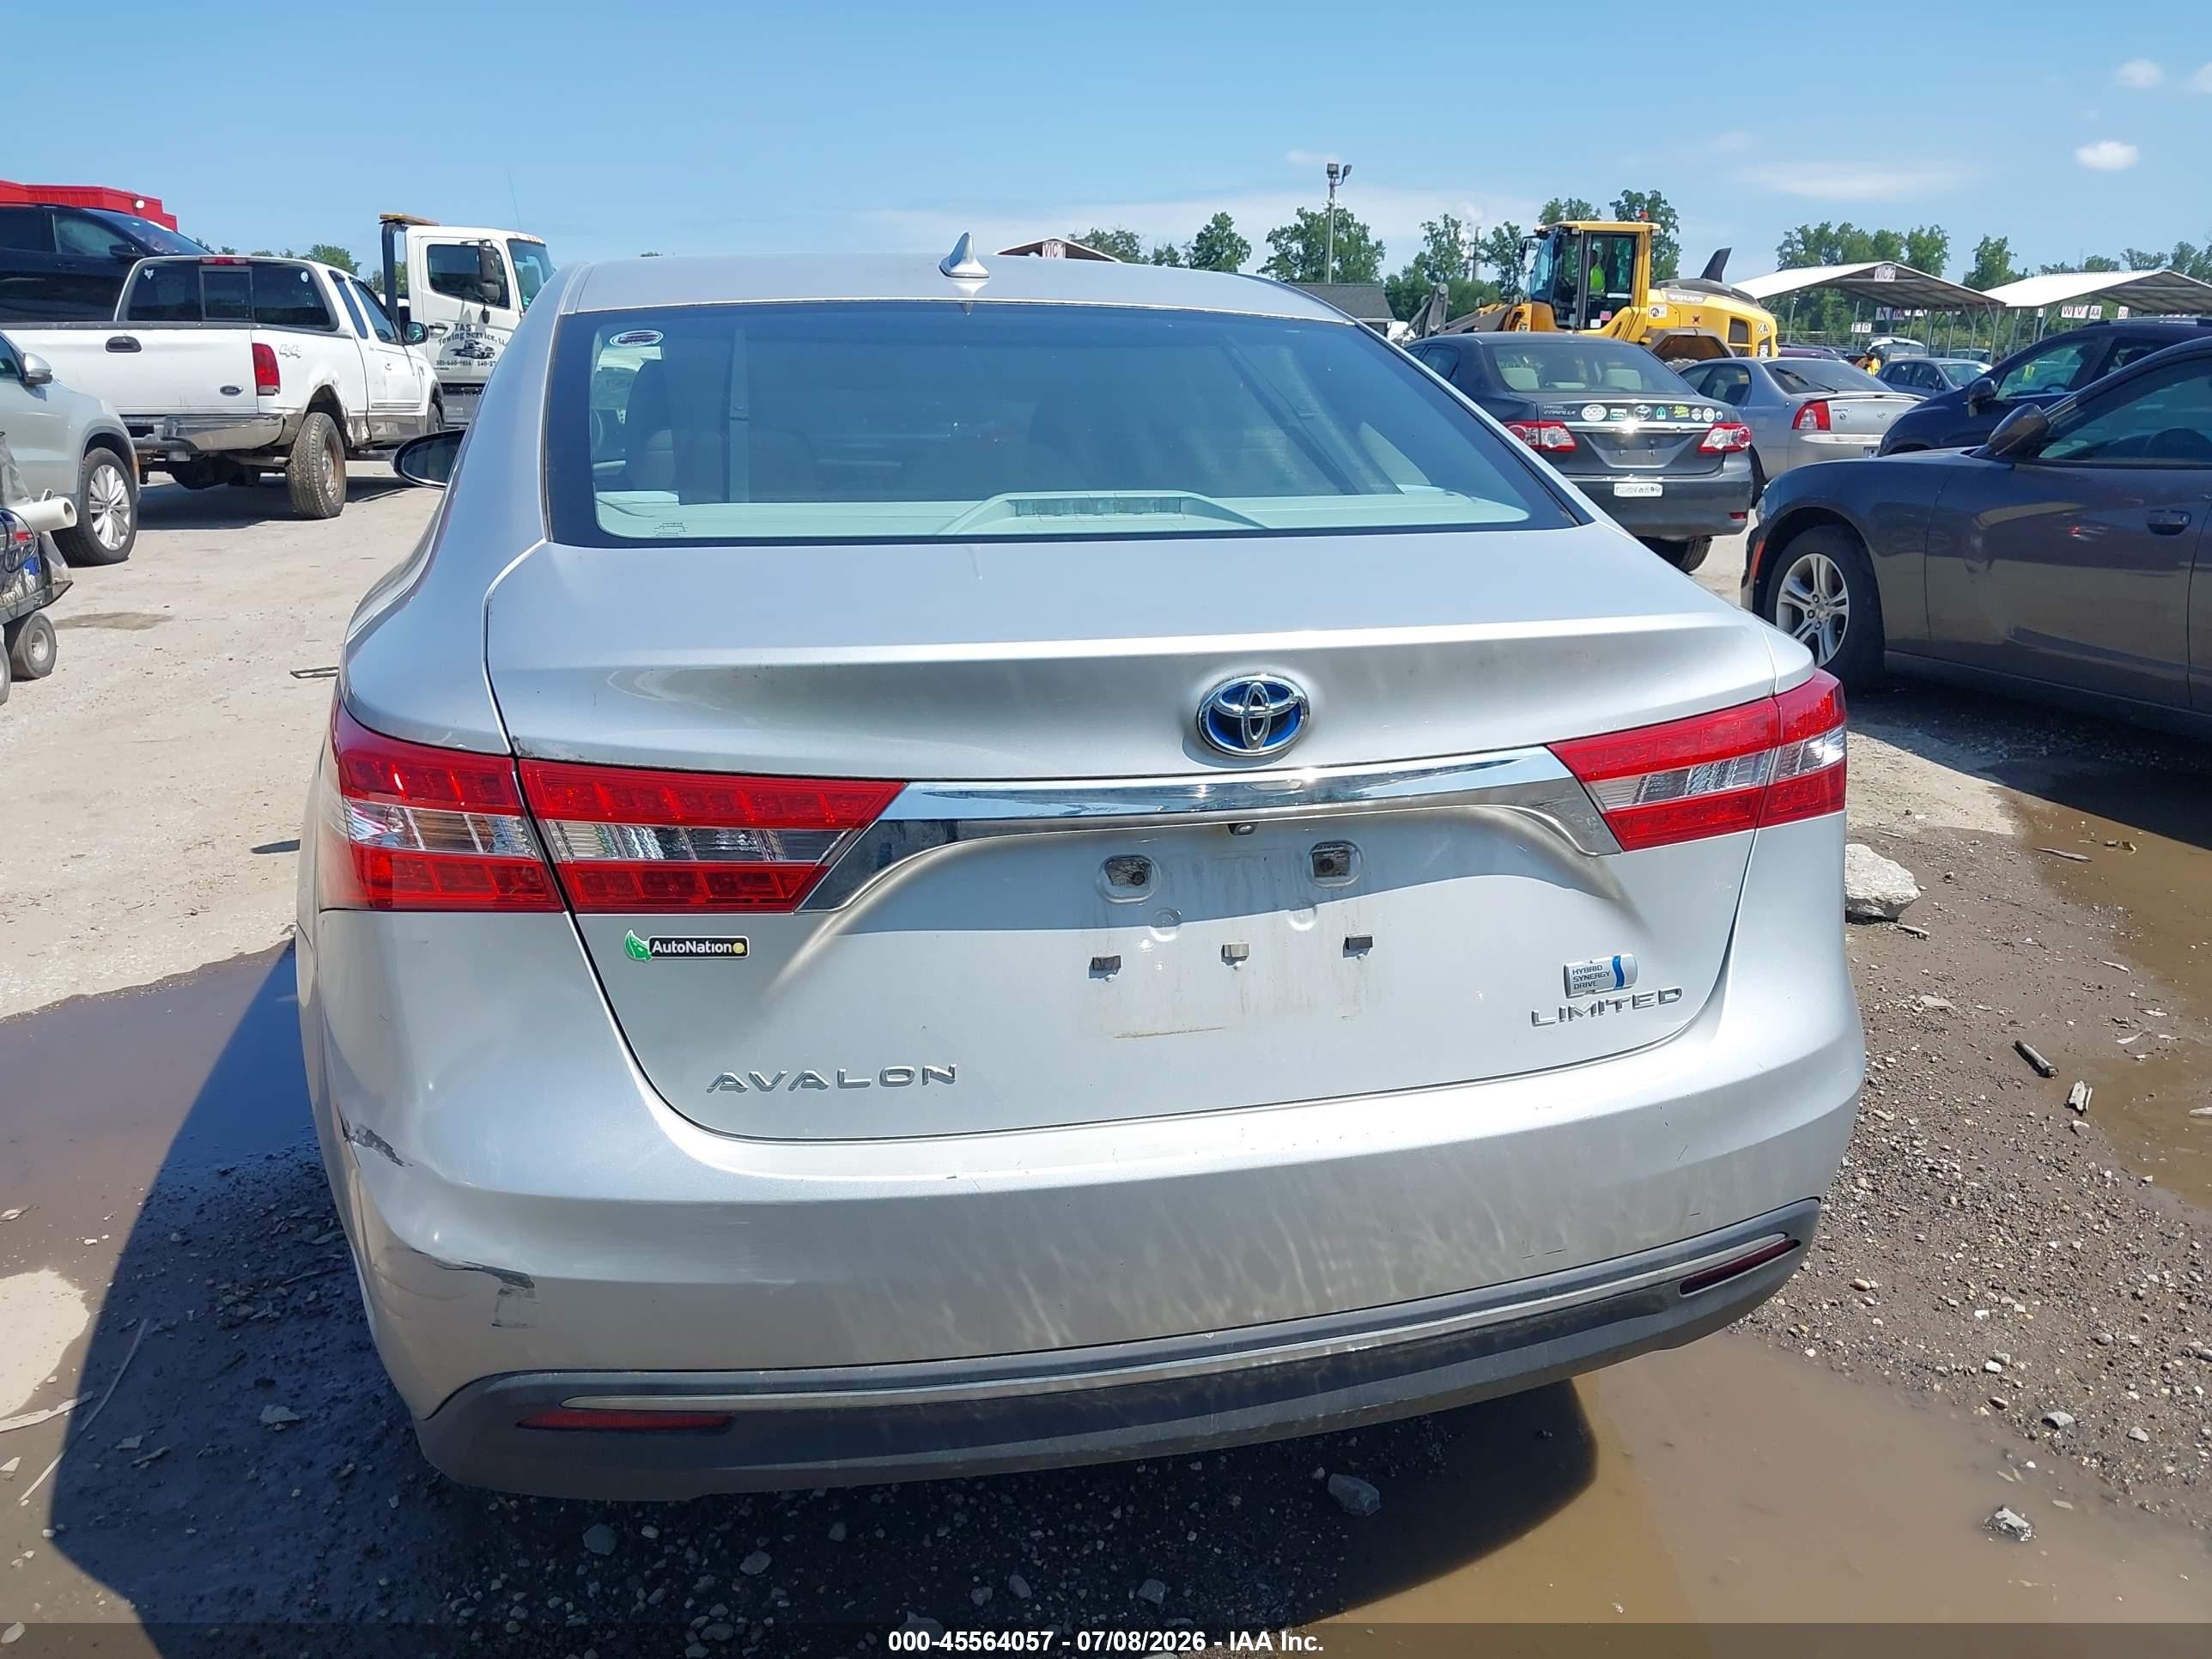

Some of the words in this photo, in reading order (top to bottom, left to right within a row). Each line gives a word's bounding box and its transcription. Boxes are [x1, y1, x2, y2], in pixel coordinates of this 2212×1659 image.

[1889, 267, 1894, 279] 2
[454, 323, 471, 331] TAS
[439, 331, 465, 346] Towing
[652, 940, 732, 953] AutoNation
[1572, 964, 1603, 975] HYBRID
[1573, 971, 1611, 983] SYNERGY
[1574, 981, 1599, 990] DRIVE
[1531, 987, 1683, 1027] LIMITED
[706, 1063, 957, 1093] AVALON
